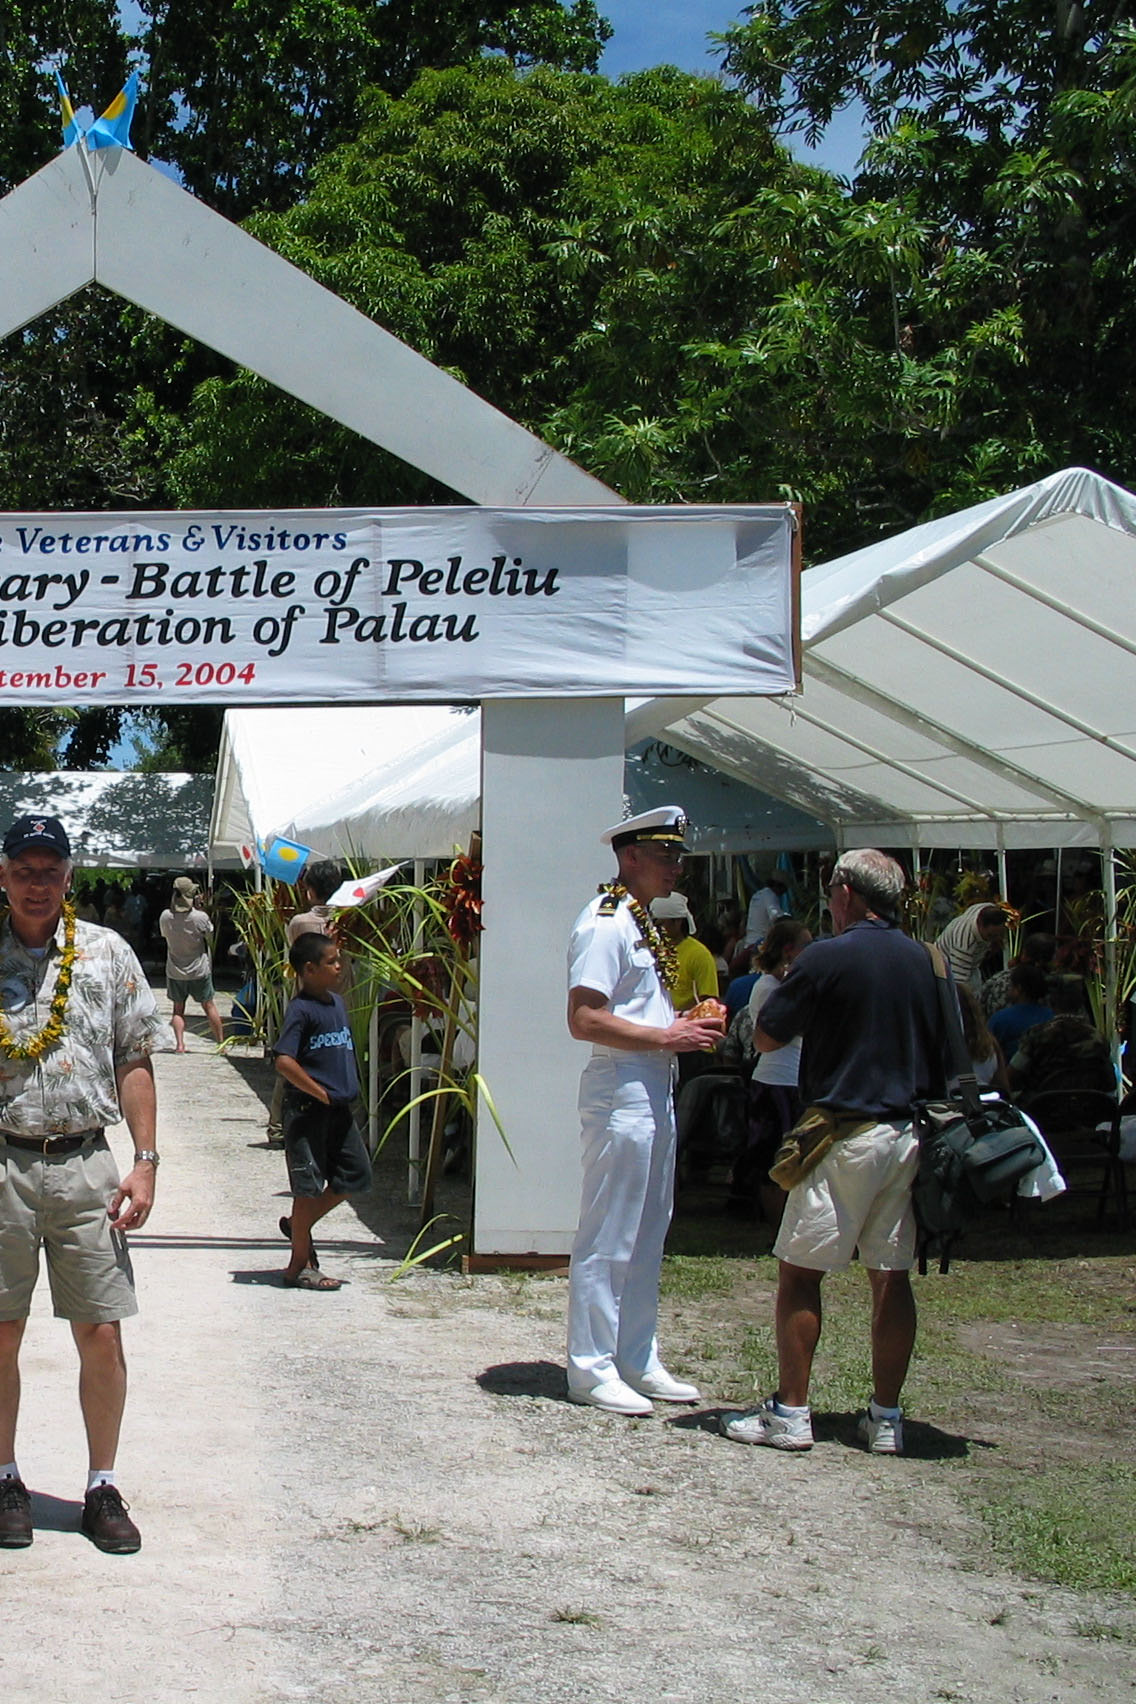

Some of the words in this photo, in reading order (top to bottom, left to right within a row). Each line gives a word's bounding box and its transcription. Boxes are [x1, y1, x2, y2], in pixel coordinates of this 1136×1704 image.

[15, 527, 172, 554] Veterans
[182, 524, 206, 552] &
[210, 524, 347, 551] Visitors
[313, 557, 370, 607] of
[380, 554, 561, 597] Peleliu
[252, 604, 306, 658] of
[319, 601, 480, 643] Palau
[124, 663, 164, 691] 15,
[175, 662, 255, 686] 2004
